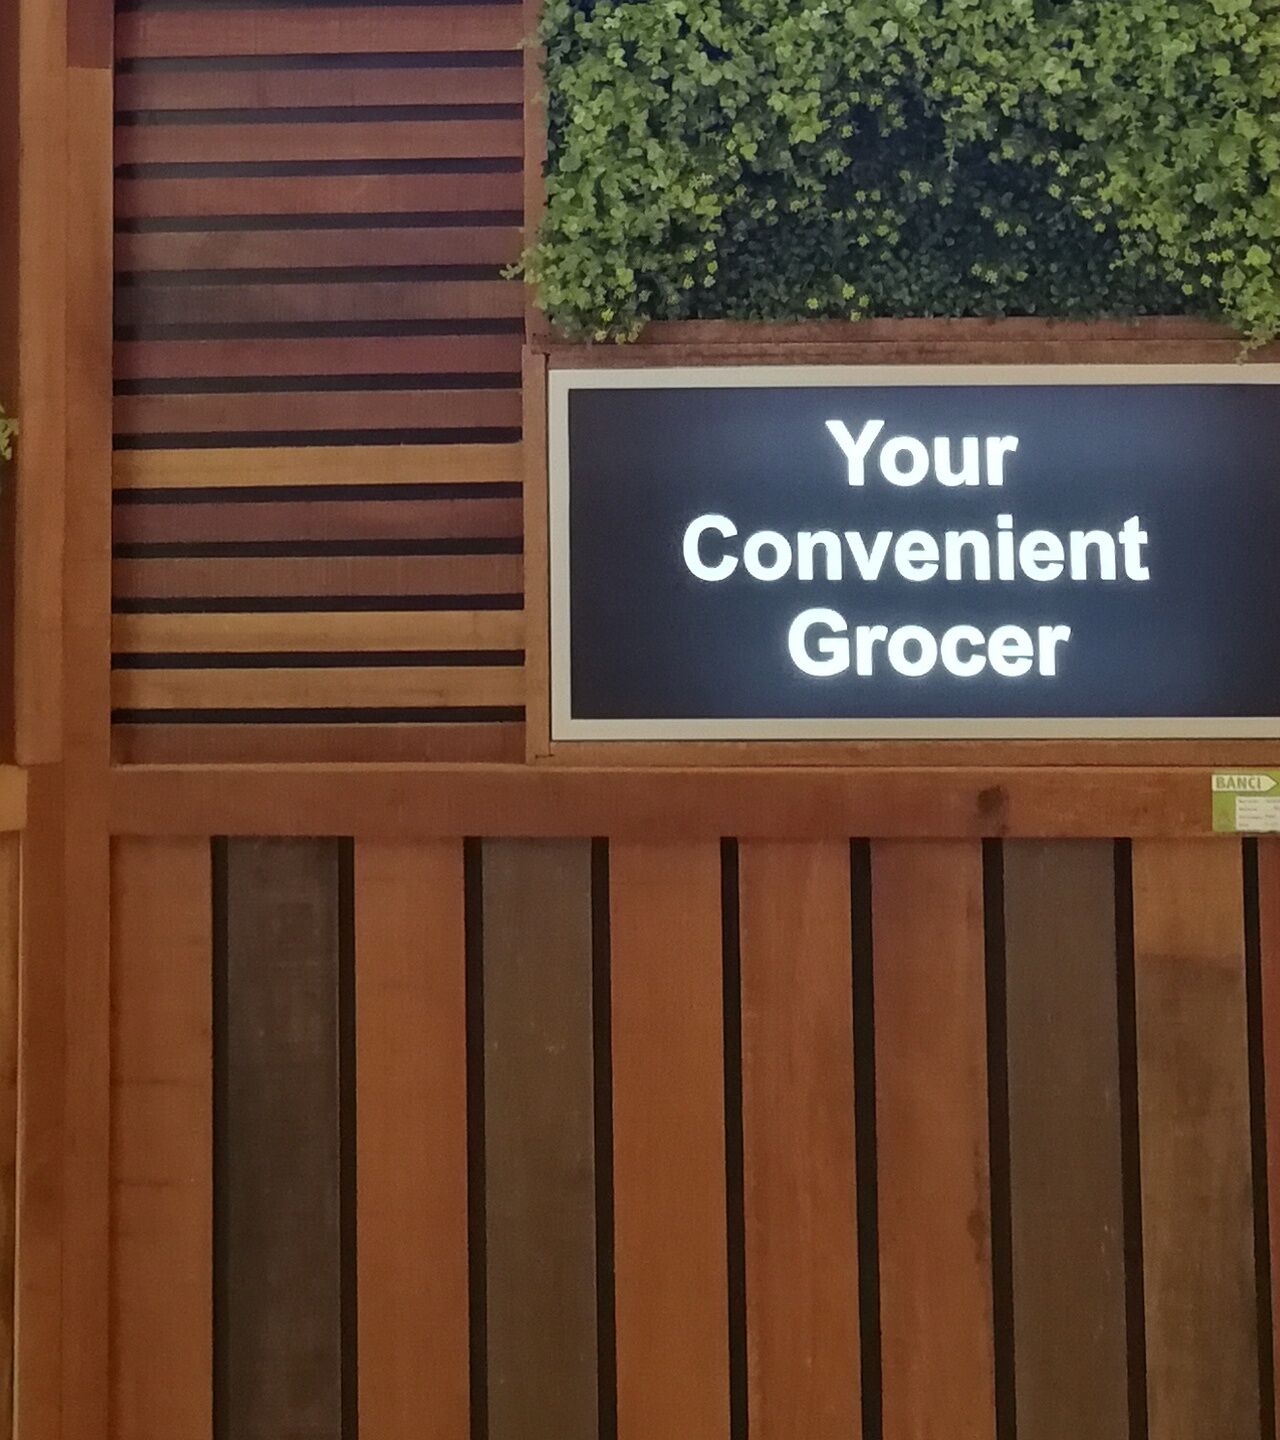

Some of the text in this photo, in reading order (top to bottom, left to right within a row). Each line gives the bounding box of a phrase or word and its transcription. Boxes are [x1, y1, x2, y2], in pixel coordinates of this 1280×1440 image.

[824, 418, 1020, 488] Your
[681, 513, 1151, 582] Convenient
[786, 607, 1072, 678] Grocer
[1215, 775, 1262, 790] BANCI
